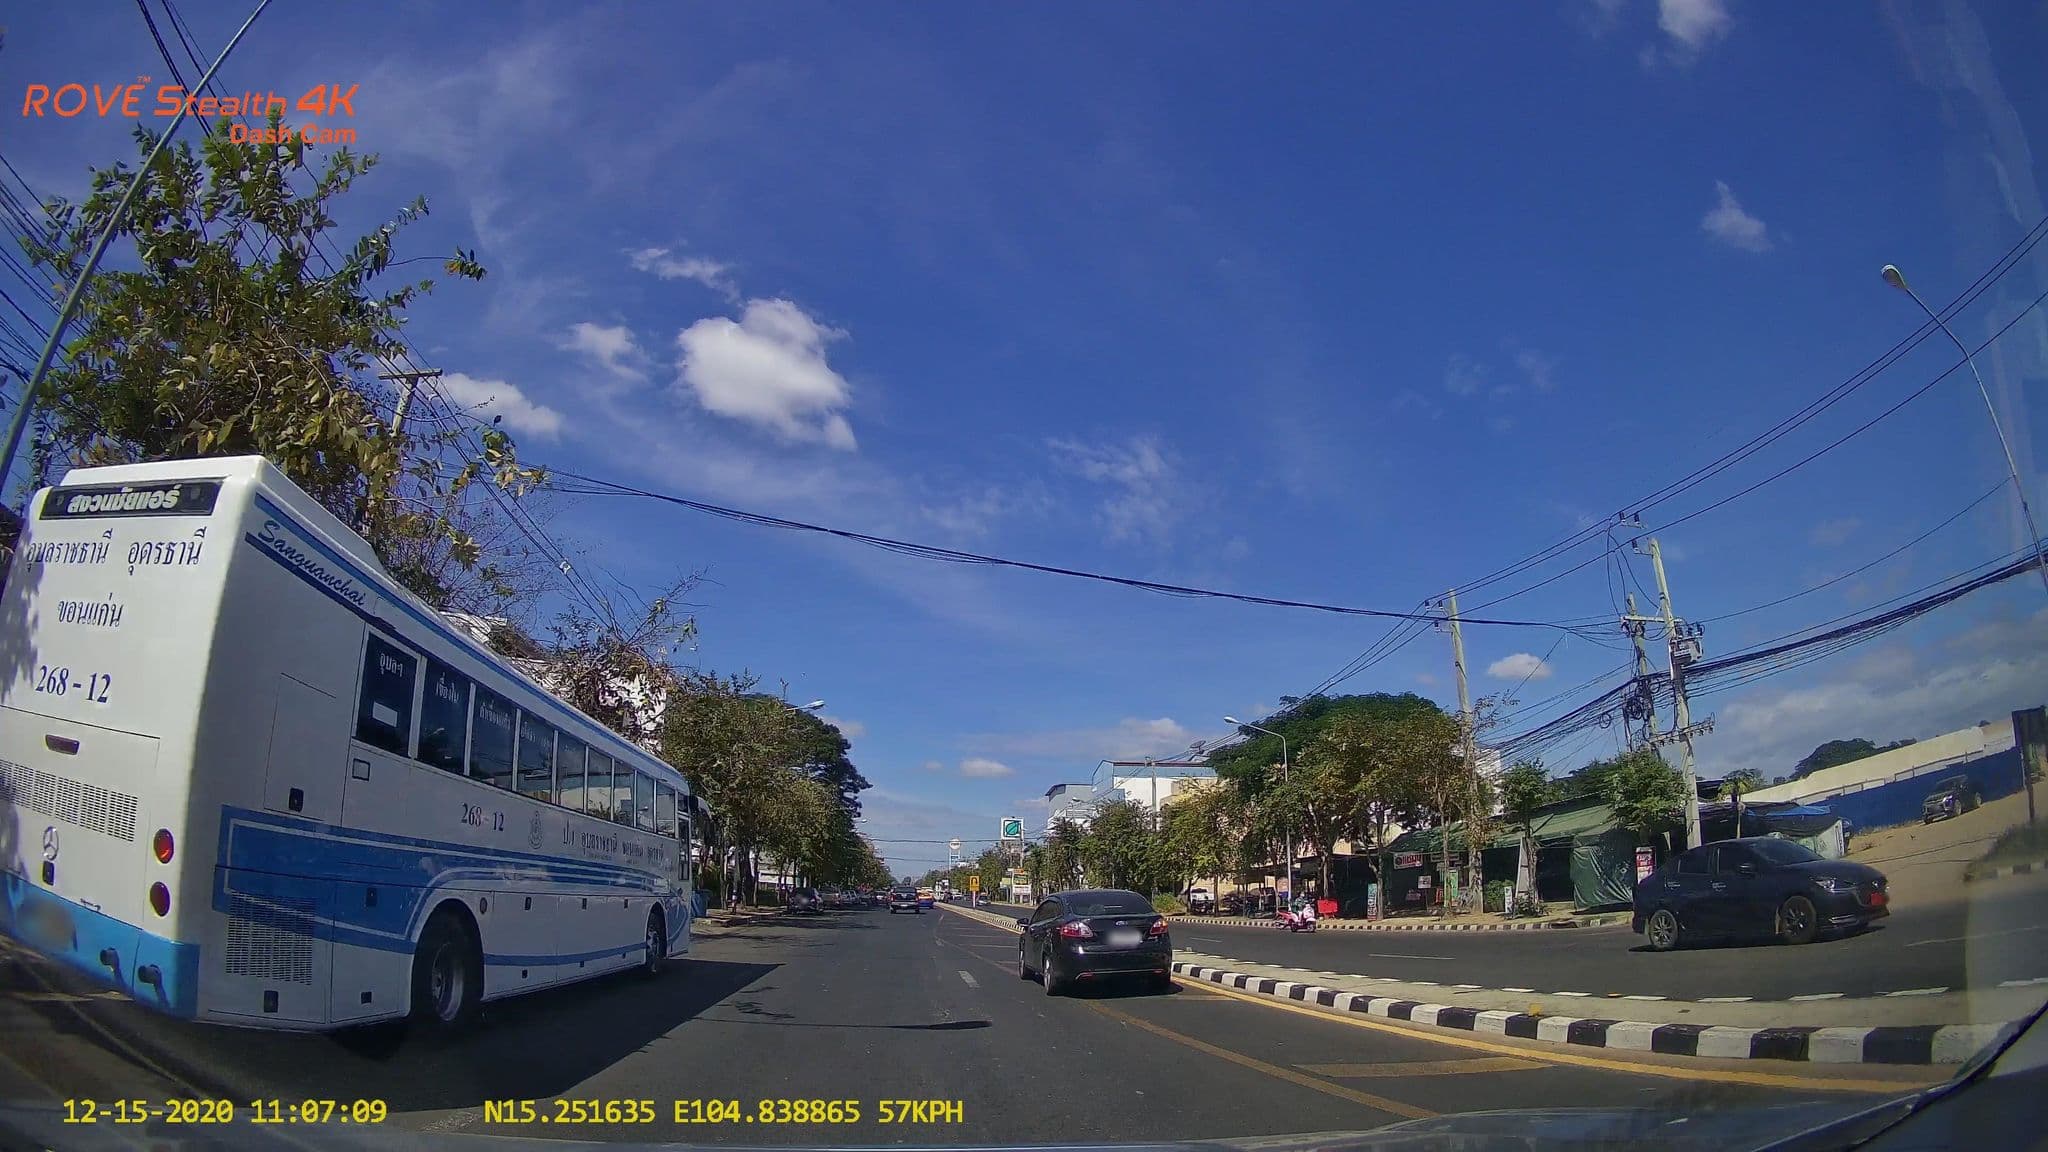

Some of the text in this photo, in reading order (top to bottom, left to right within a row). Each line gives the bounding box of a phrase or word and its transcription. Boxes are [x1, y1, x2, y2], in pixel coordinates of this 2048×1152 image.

[66, 484, 182, 513] สงวนชัยแอร์
[26, 526, 207, 576] อุบลราชธานี อุดรธานี
[258, 519, 367, 607] Sanguanchai
[58, 592, 123, 628] ขอนแก่น
